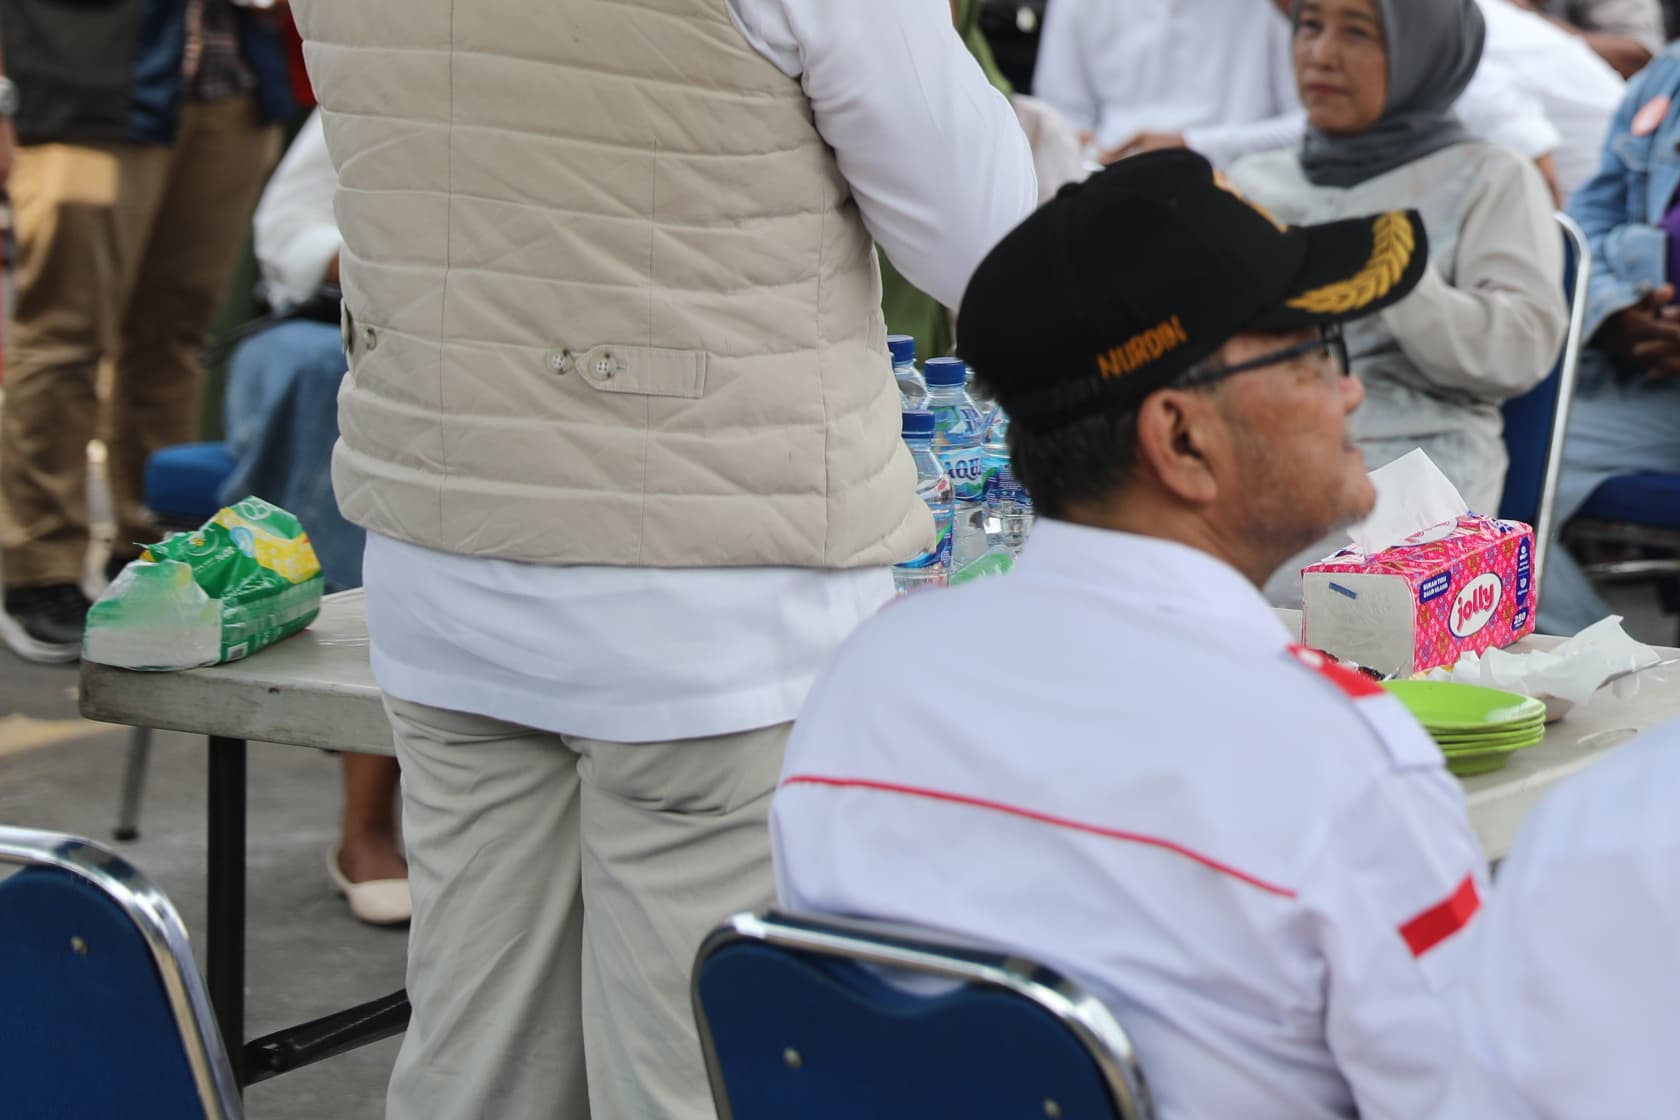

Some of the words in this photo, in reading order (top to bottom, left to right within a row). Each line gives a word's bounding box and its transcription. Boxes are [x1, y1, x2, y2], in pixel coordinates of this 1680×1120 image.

[1097, 314, 1187, 380] NURDIN
[945, 457, 982, 481] AQU
[1457, 584, 1495, 634] jolly
